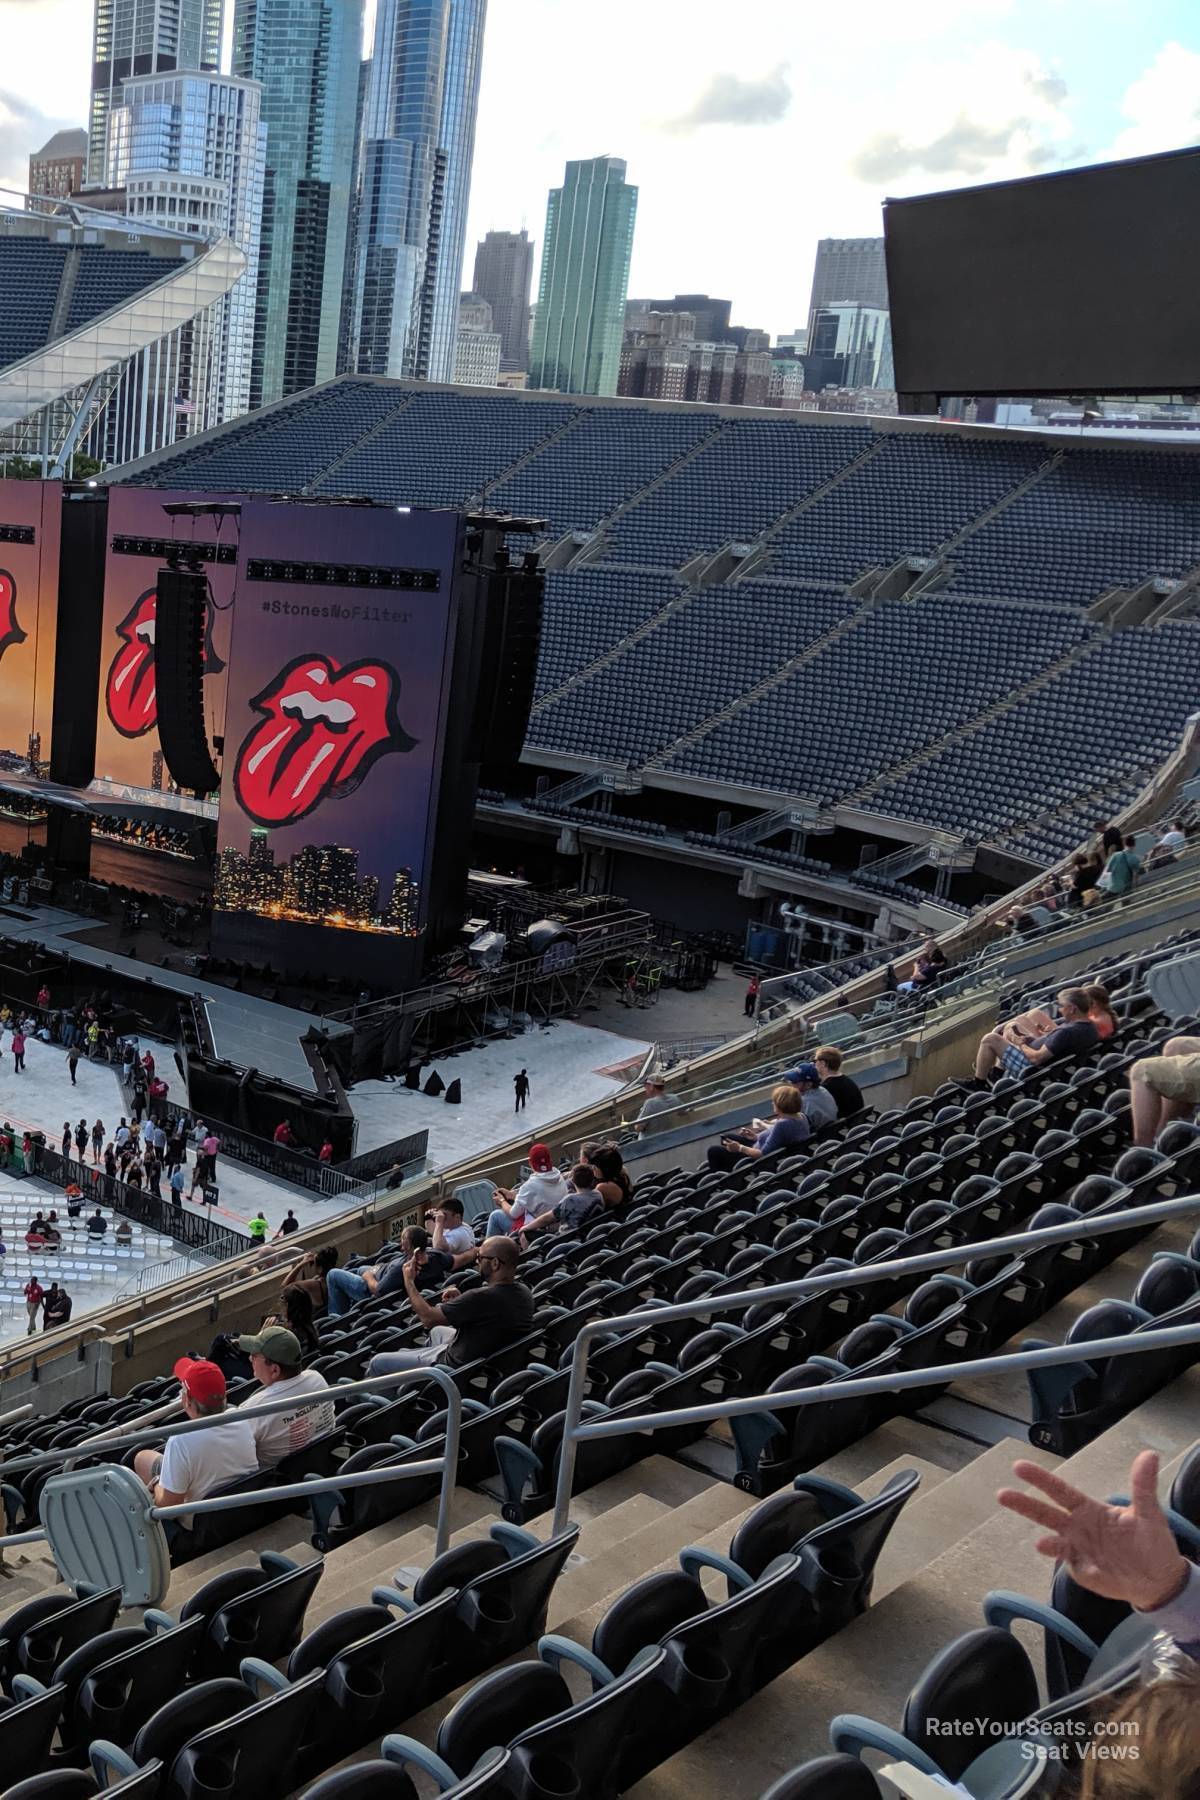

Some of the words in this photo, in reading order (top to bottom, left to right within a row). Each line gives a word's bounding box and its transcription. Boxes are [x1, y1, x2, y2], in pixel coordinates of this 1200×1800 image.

[262, 600, 413, 623] #StonesNoFilter
[282, 1416, 296, 1424] The
[1040, 1430, 1051, 1444] 13
[741, 1478, 751, 1491] 12
